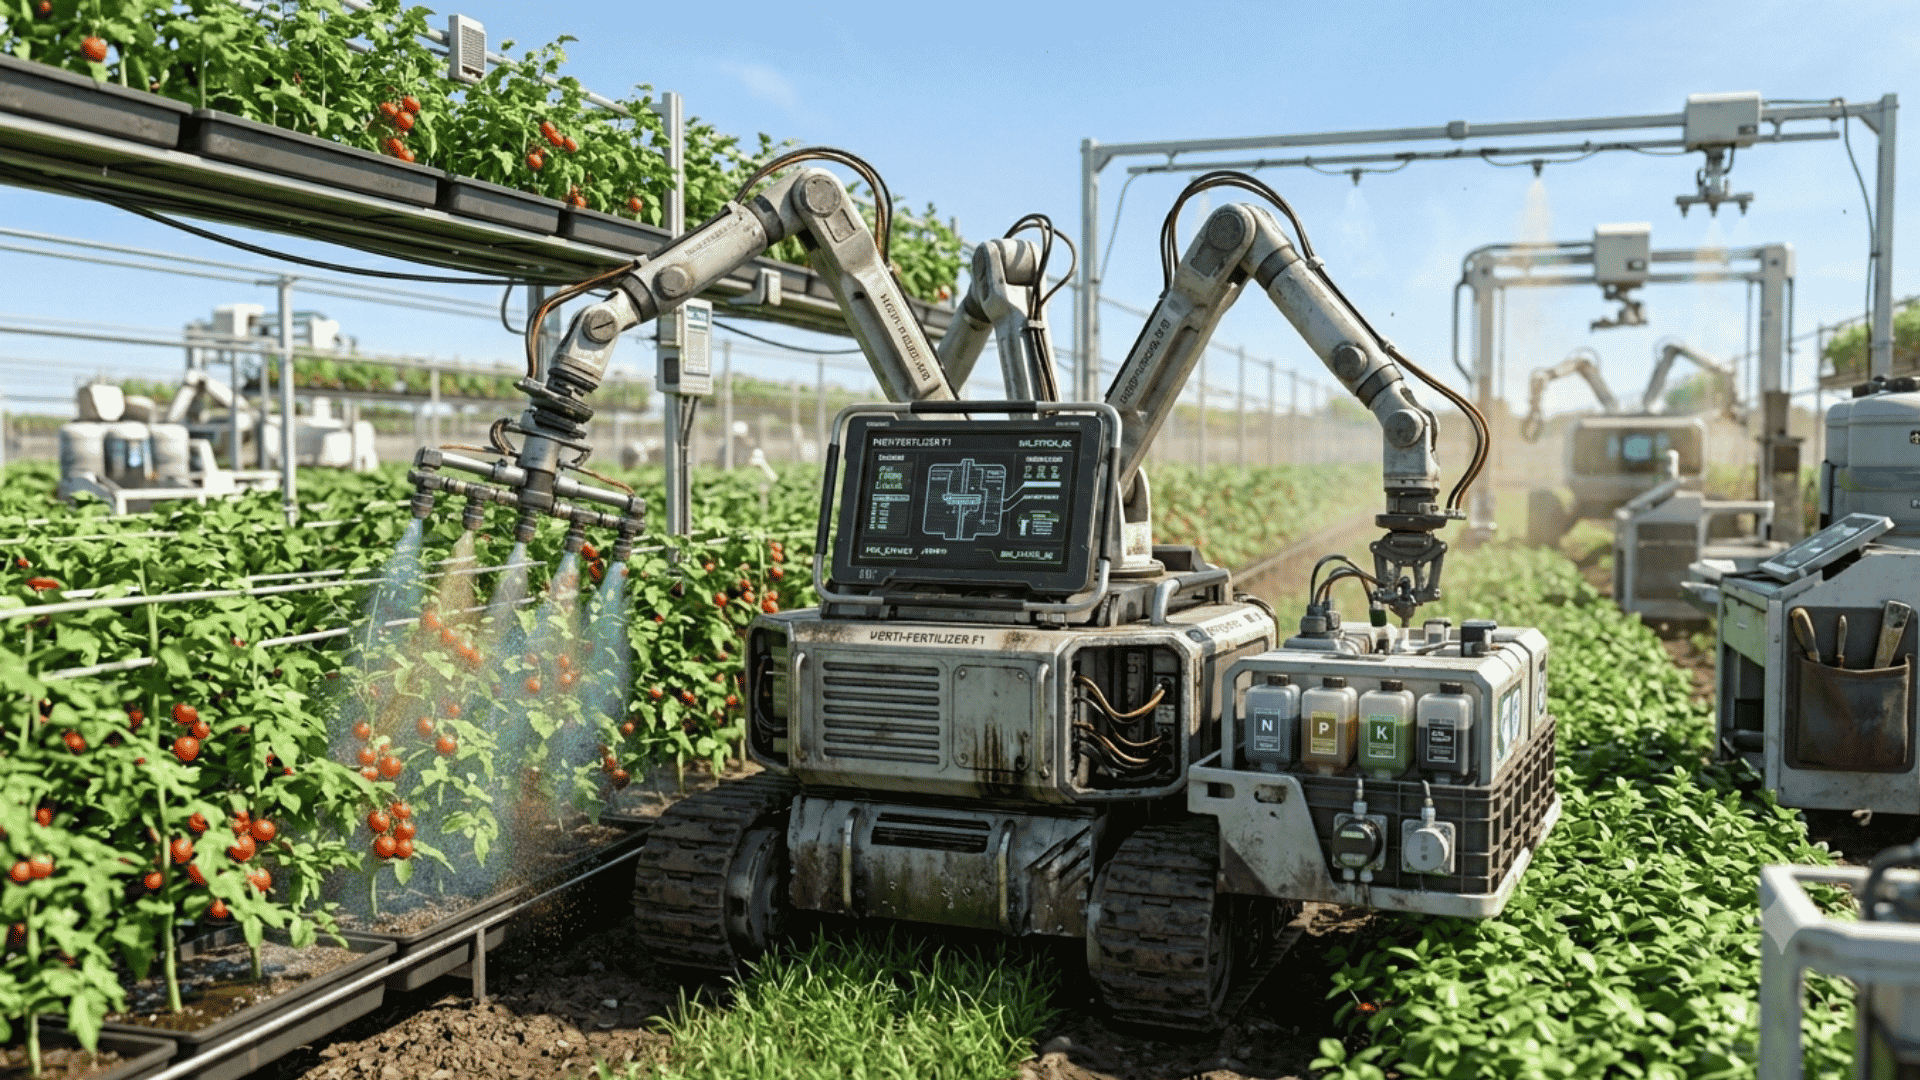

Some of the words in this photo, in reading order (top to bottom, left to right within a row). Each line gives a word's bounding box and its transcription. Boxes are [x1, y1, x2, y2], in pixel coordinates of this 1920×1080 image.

[972, 634, 985, 645] F1
[1262, 719, 1273, 732] N
[1319, 722, 1329, 735] P
[1376, 725, 1388, 740] K
